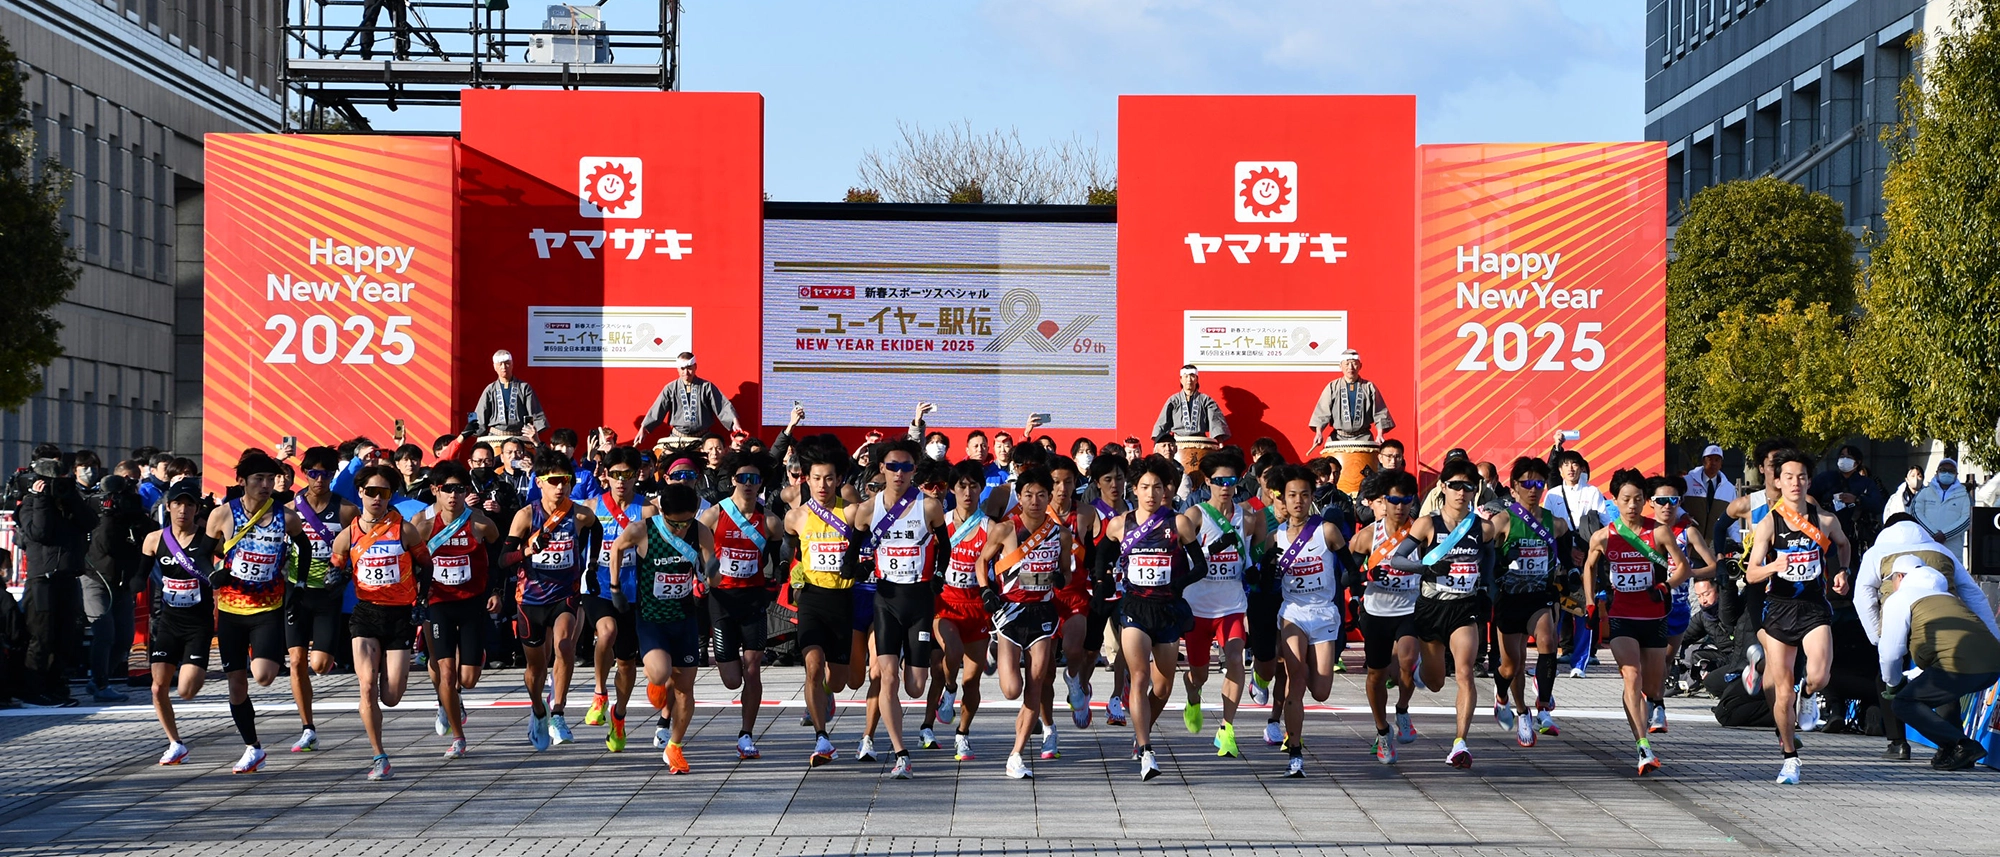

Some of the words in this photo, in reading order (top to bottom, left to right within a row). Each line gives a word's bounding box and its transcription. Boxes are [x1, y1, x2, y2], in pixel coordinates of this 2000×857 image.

[528, 228, 693, 260] ヤマザキ
[1184, 232, 1348, 264] ヤマザキ
[309, 237, 415, 274] Happy
[1456, 245, 1561, 281] Happy
[266, 273, 341, 302] New
[342, 274, 415, 303] Year
[812, 288, 852, 297] ヤマザキ
[865, 286, 990, 299] 新春スポーツスペシャル
[1456, 281, 1529, 309] New
[1530, 281, 1603, 309] Year
[796, 306, 992, 335] ニューイヤー駅伝
[262, 313, 416, 366] 2025
[543, 331, 633, 345] ニューイヤー駅伝
[1200, 336, 1289, 349] ニューイヤー駅伝
[796, 338, 829, 351] NEW
[836, 339, 874, 351] YEAR
[881, 340, 934, 351] EKIDEN
[941, 340, 975, 352] 2025
[1454, 321, 1606, 372] 2025
[887, 547, 919, 555] ヤマザキ
[540, 552, 571, 564] 29-1
[818, 553, 842, 565] 33-
[889, 558, 917, 570] 8-1
[1138, 557, 1168, 565] ヤマザキ
[1519, 558, 1545, 570] 16-1
[240, 562, 271, 576] 35-1
[441, 568, 465, 579] 4-1
[730, 560, 754, 574] 5-1
[1138, 567, 1167, 580] 13-1
[1209, 563, 1237, 576] 36-1
[1293, 564, 1322, 574] ヤマザキ
[1618, 564, 1649, 572] ヤマザキ
[1786, 563, 1817, 576] 20-1
[365, 568, 395, 580] 28-1
[1295, 576, 1322, 589] 2-1
[1617, 575, 1648, 587] 24-1
[168, 590, 196, 602] 7-1
